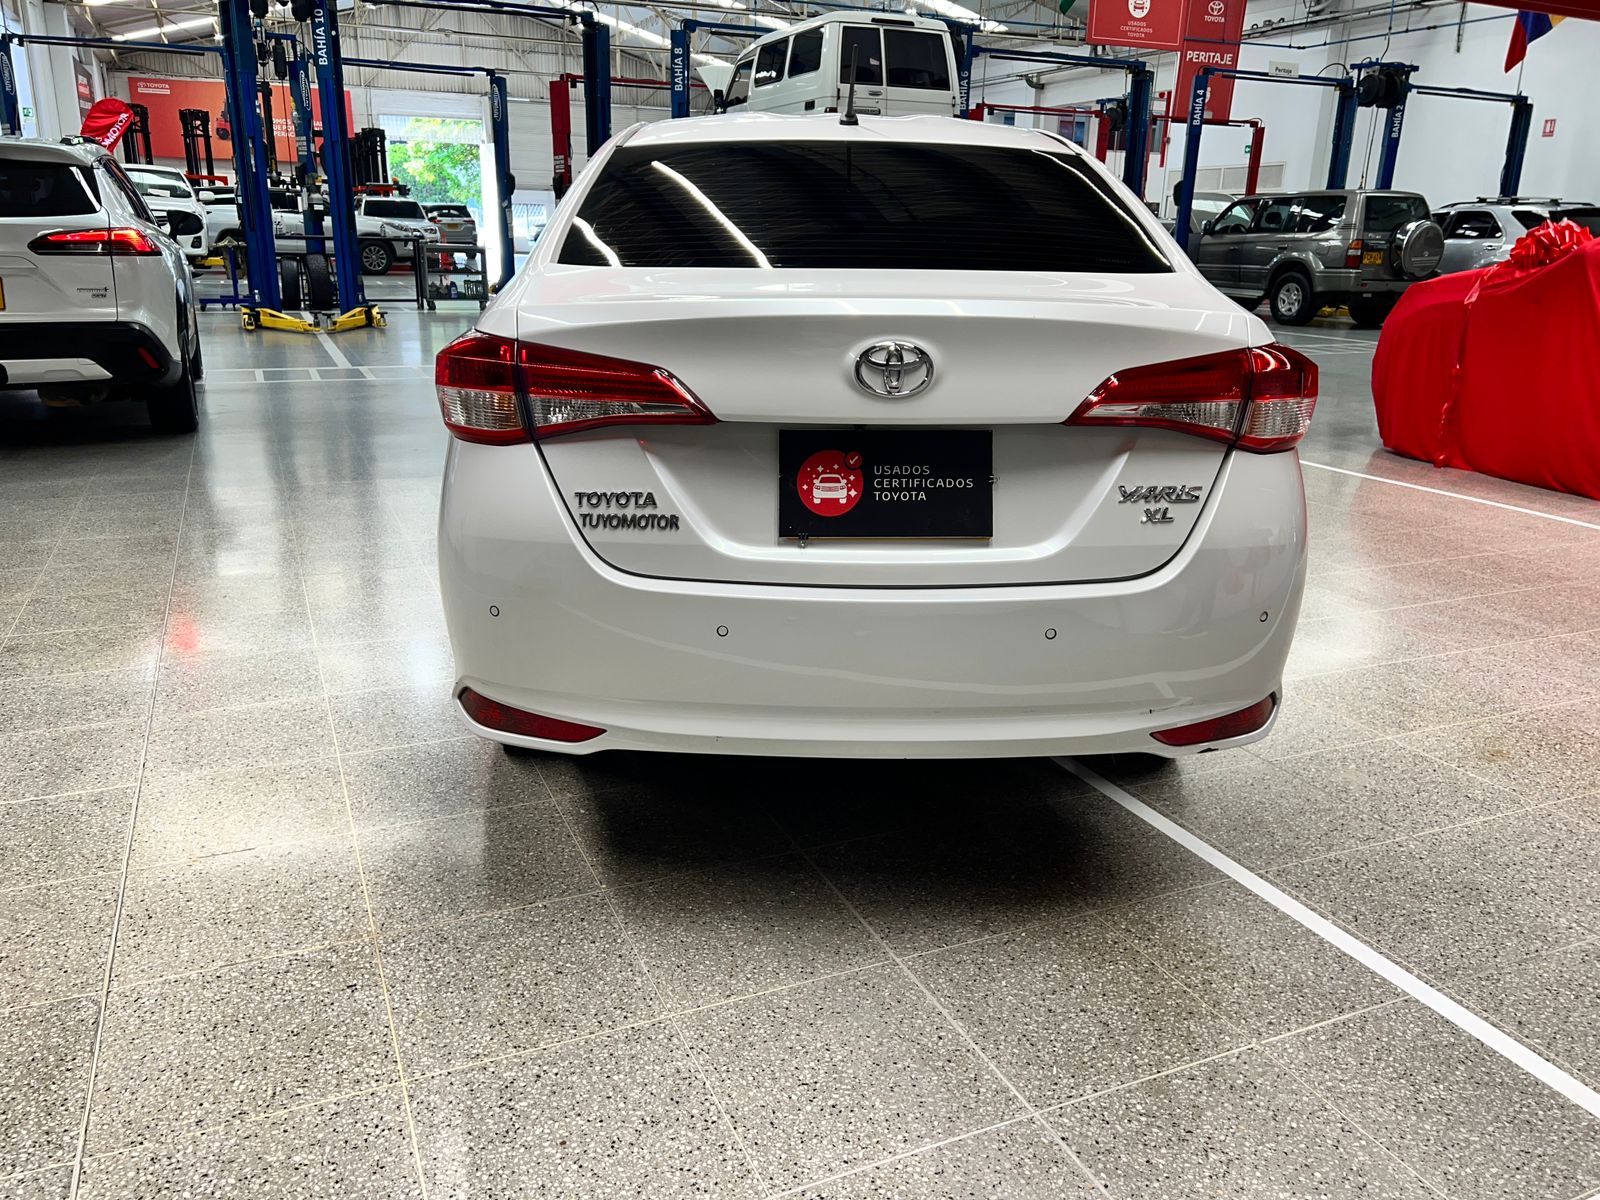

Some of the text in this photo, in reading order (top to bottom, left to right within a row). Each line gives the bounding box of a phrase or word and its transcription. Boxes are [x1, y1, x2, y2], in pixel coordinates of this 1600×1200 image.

[1204, 15, 1225, 23] TOYOTA
[314, 9, 328, 65] BAHÍA 10
[1120, 25, 1153, 34] CERTIFICADOS
[1186, 51, 1233, 64] PERITAJE
[672, 57, 683, 91] BAHÍA
[1193, 96, 1204, 125] BAHÍA
[1391, 111, 1403, 138] BAHÍA
[873, 465, 930, 475] USADOS
[873, 478, 974, 488] CERTIFICADOS
[575, 491, 657, 509] TOYOTA
[873, 491, 927, 501] TOYOTA
[1118, 485, 1203, 503] YARIS
[580, 513, 680, 530] TUYOMOTOR
[1140, 507, 1174, 524] XL
